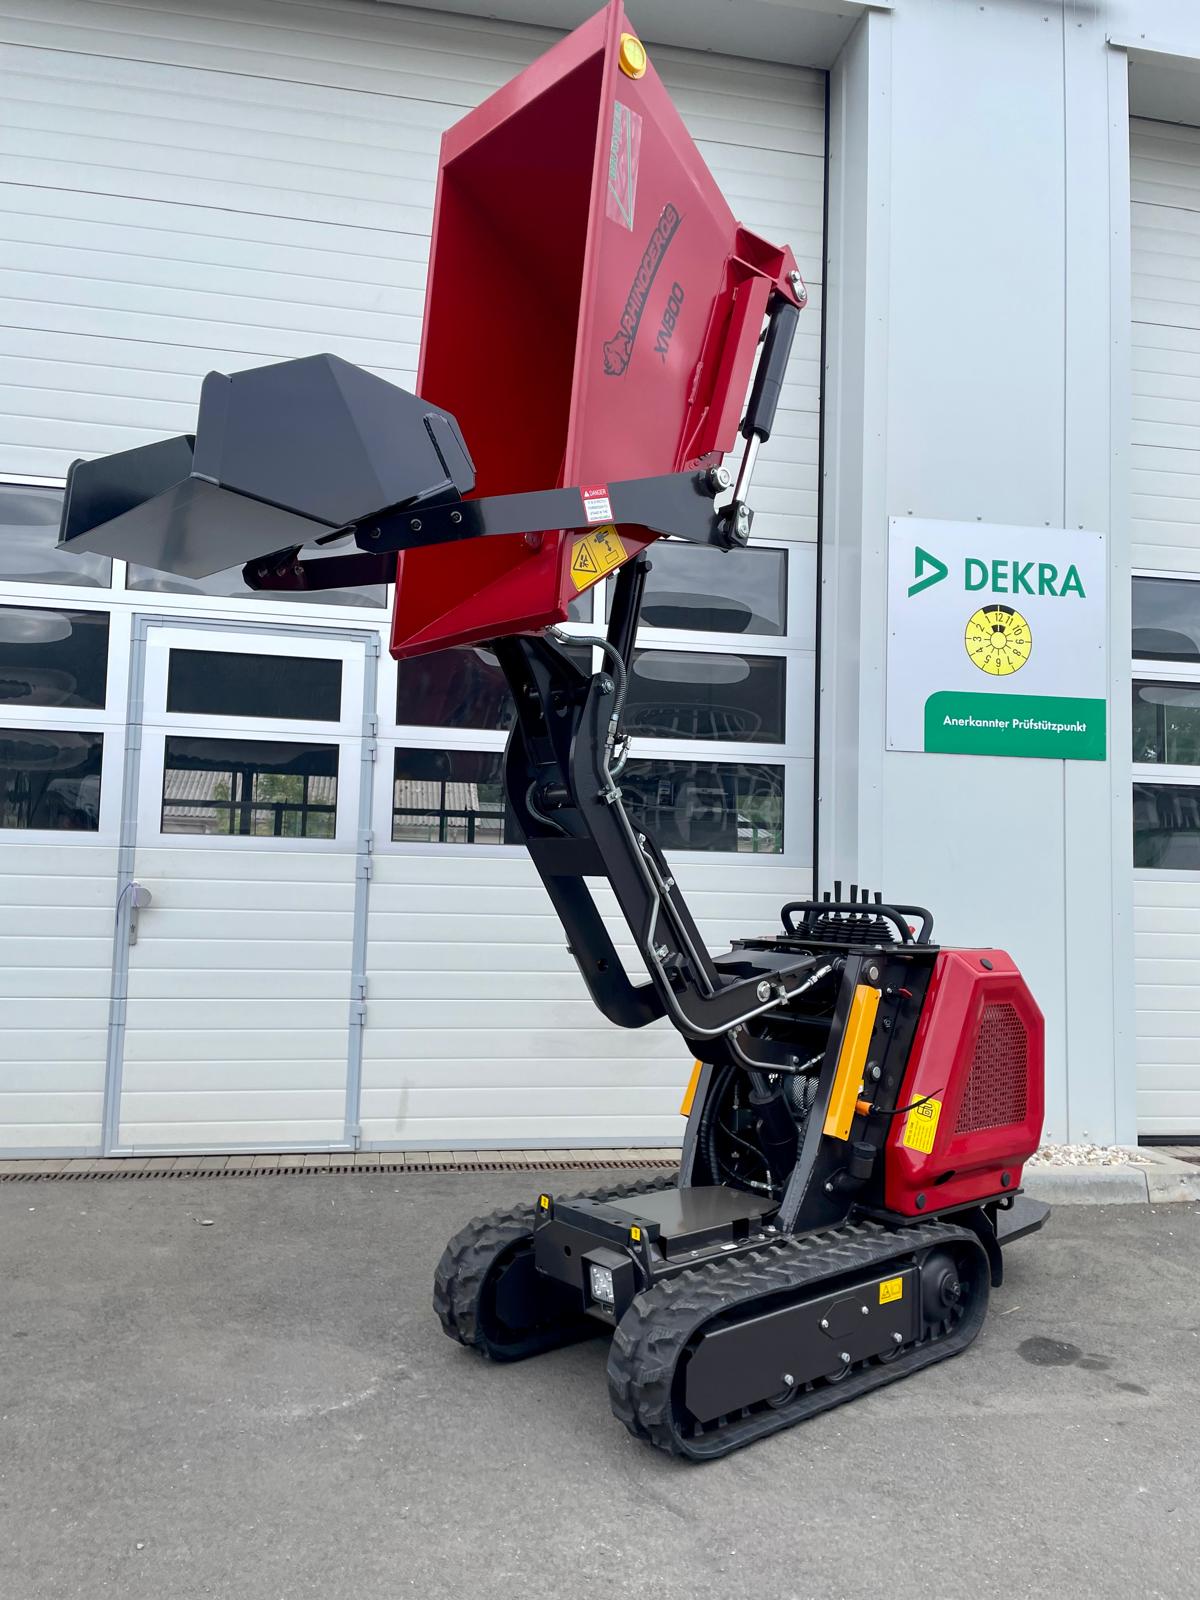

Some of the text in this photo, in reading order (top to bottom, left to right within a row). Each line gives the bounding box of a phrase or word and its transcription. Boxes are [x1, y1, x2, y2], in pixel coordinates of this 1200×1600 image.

[589, 488, 606, 496] DANGER
[965, 558, 1086, 598] DEKRA
[985, 615, 991, 624] 1
[995, 613, 1004, 622] 12
[1005, 616, 1014, 626] 11
[976, 623, 985, 632] 2
[1012, 625, 1022, 635] 10
[1012, 648, 1022, 656] 8
[984, 655, 992, 664] 5
[996, 658, 1001, 667] 6
[1007, 656, 1013, 665] 7
[943, 715, 1087, 734] Anerkannter Prüfstützpunkt
